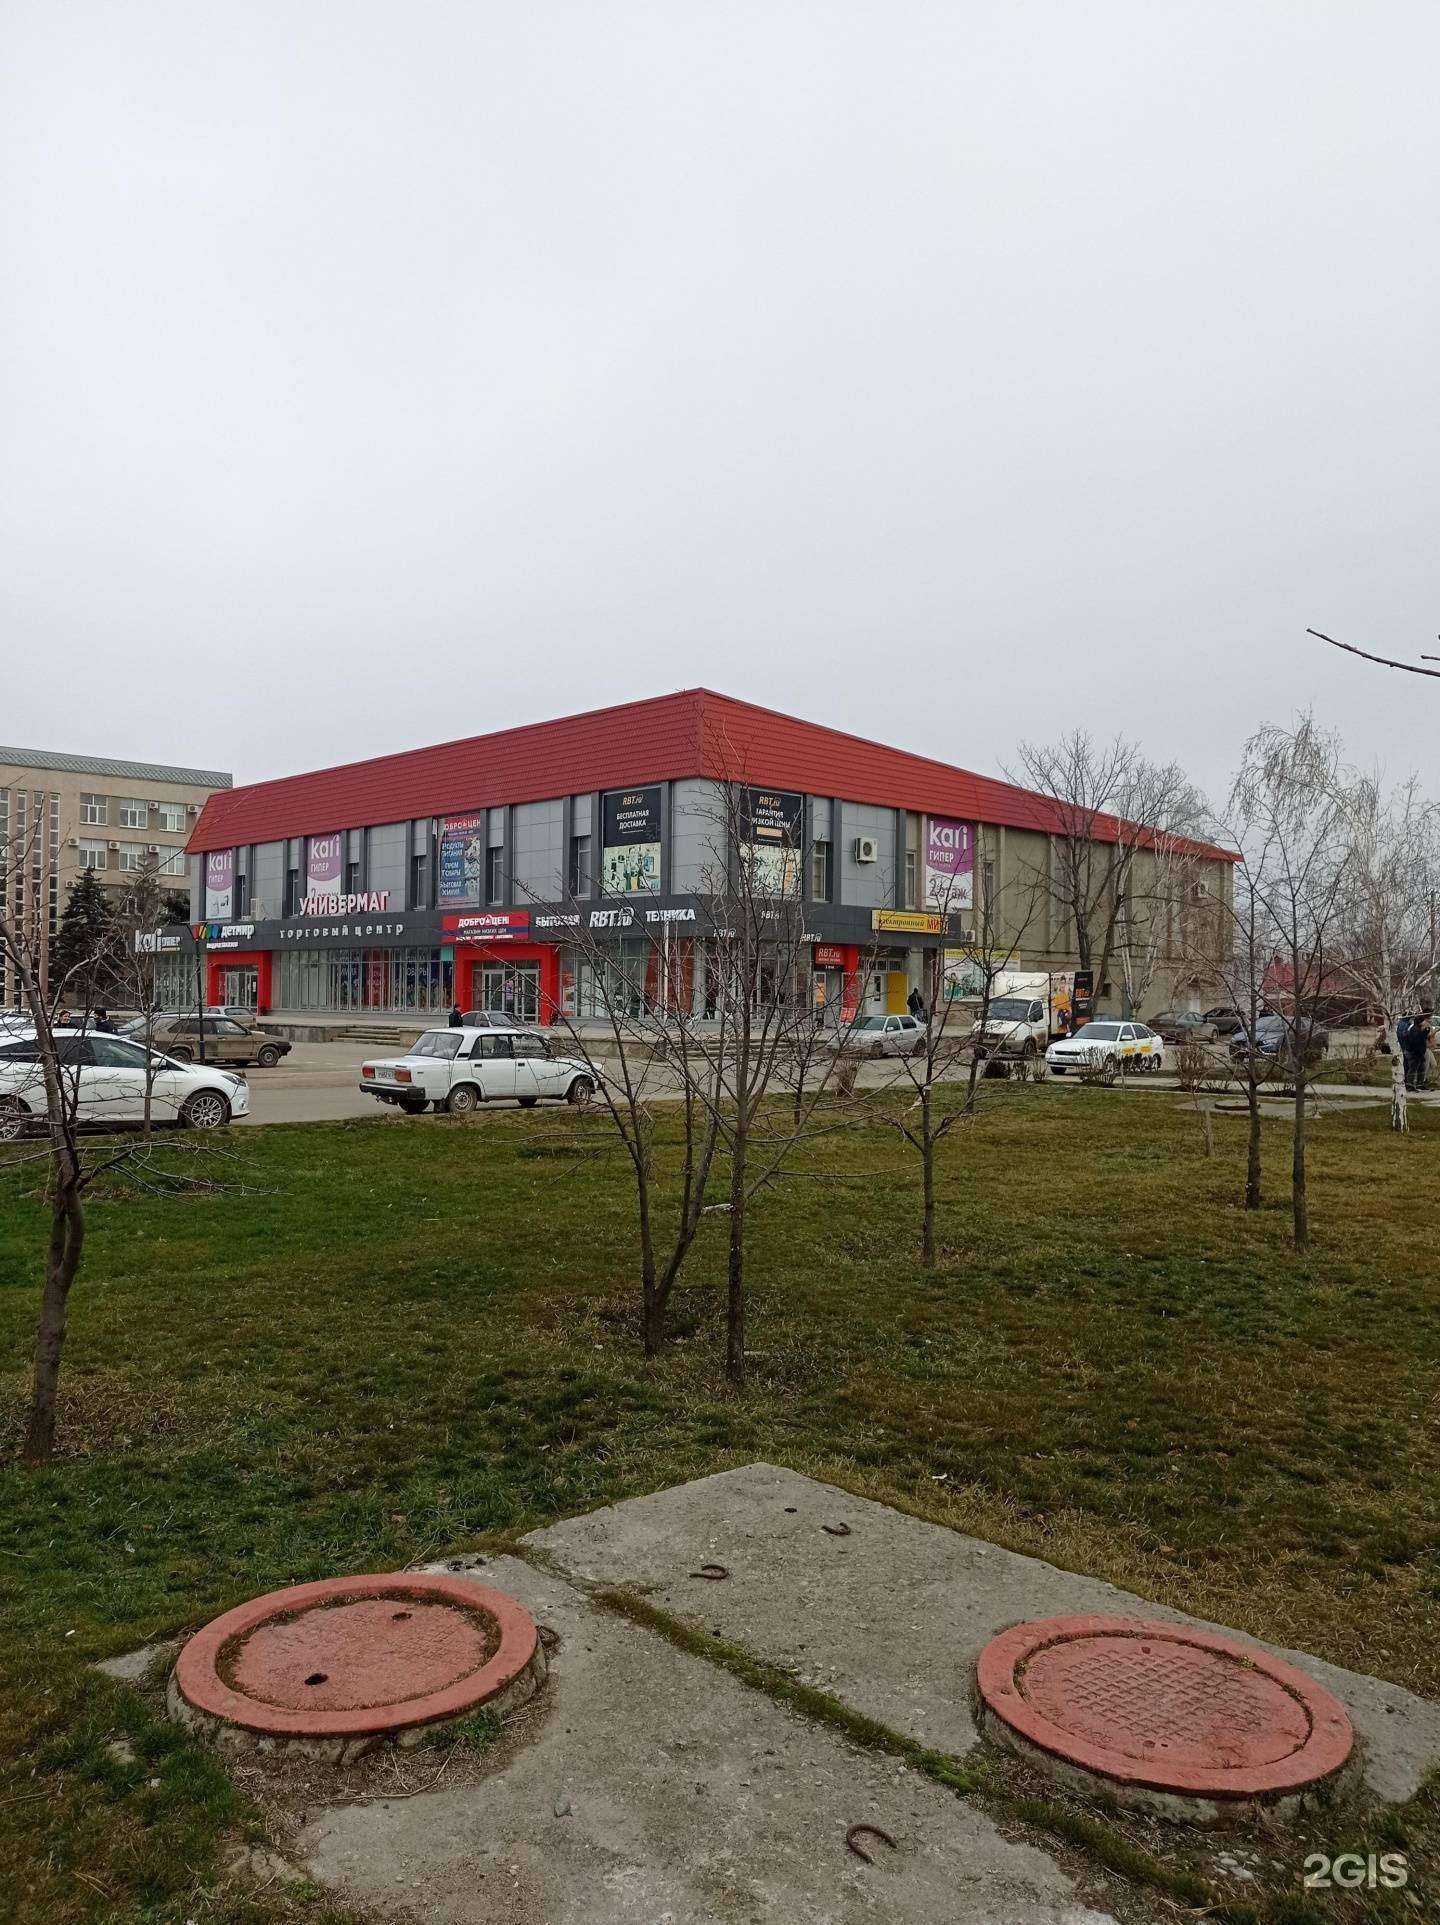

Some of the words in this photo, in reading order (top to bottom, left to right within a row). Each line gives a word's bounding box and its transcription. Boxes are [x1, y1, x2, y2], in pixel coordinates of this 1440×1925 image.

[617, 809, 649, 820] БЕСПЛАТНАЯ
[619, 820, 647, 830] ДОСТАВКА
[930, 820, 967, 850] kari
[311, 834, 340, 860] kari
[208, 851, 232, 871] kari
[929, 850, 954, 863] ГИПЕР
[298, 890, 390, 917] УНИВЕРМАГ
[645, 908, 696, 922] ТЕХНИКА
[221, 924, 255, 939] детмир
[280, 925, 349, 940] торговый
[355, 924, 404, 937] центр
